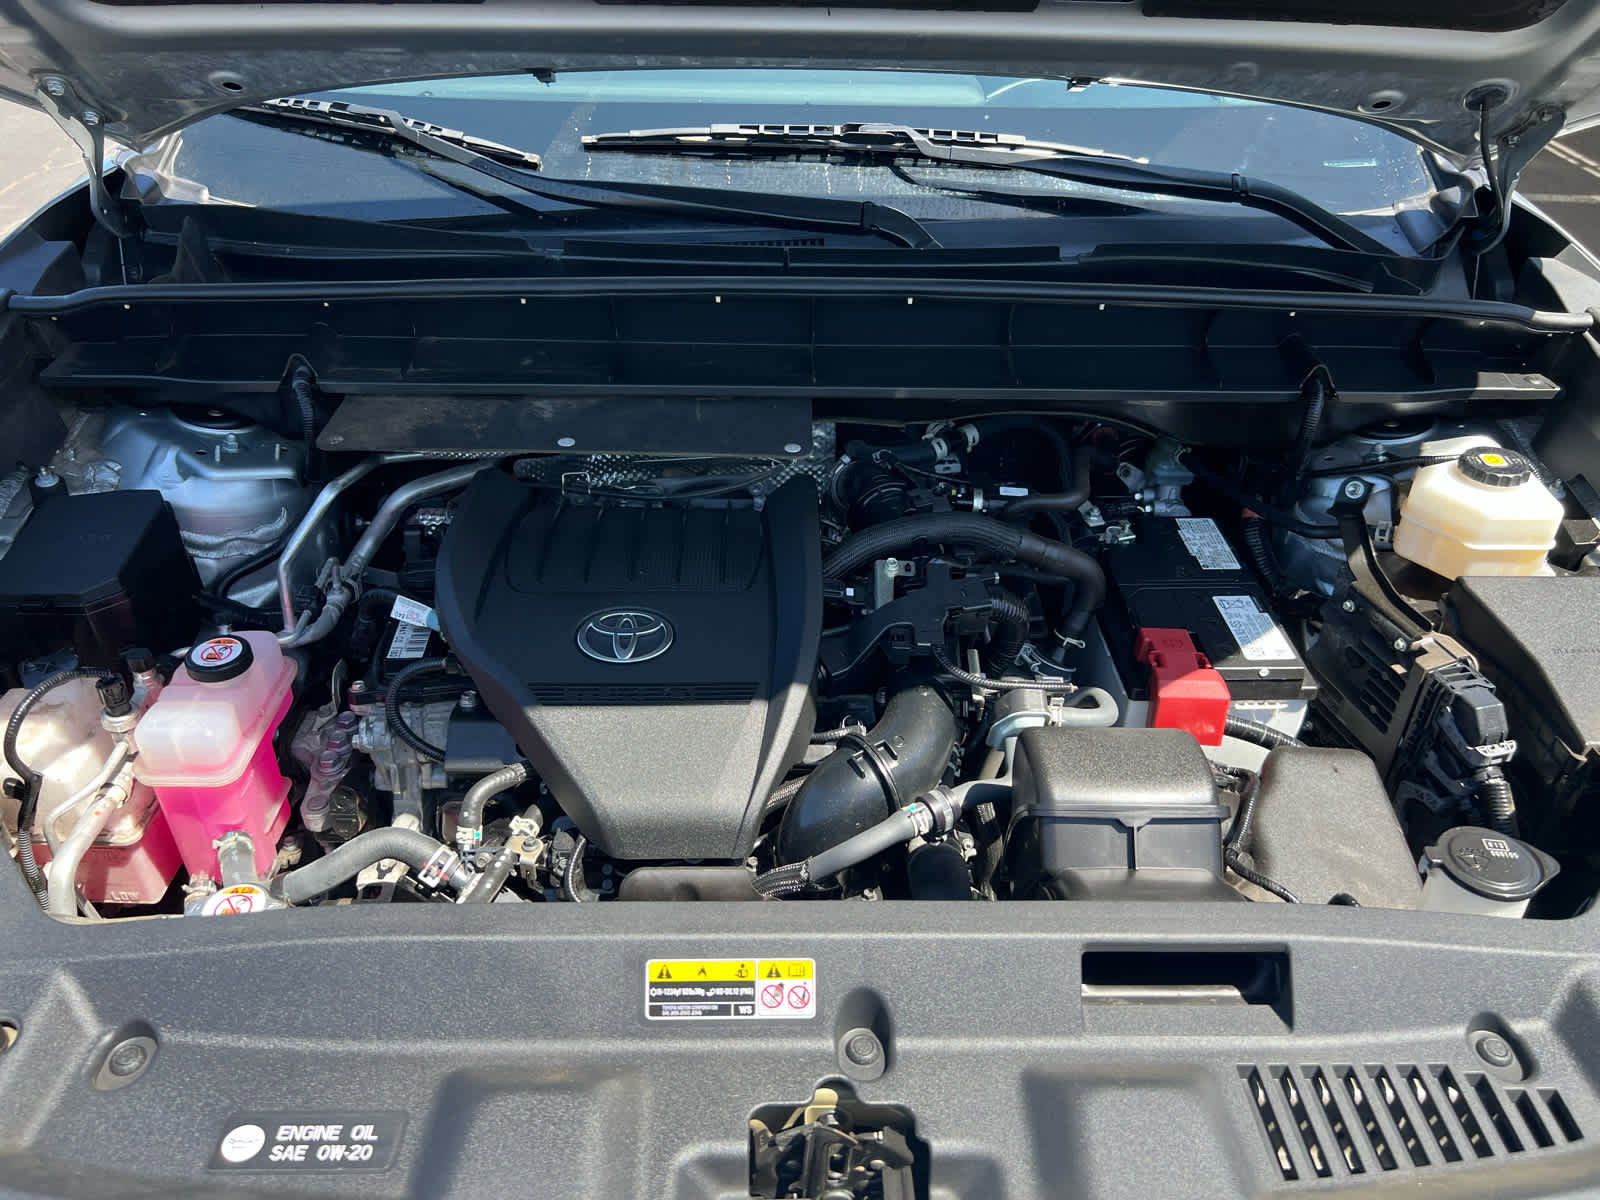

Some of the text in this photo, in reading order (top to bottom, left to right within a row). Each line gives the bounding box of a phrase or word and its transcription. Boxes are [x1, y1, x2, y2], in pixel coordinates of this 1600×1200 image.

[275, 1124, 379, 1142] ENGINE OIL
[268, 1144, 374, 1162] SAE 0W-20
